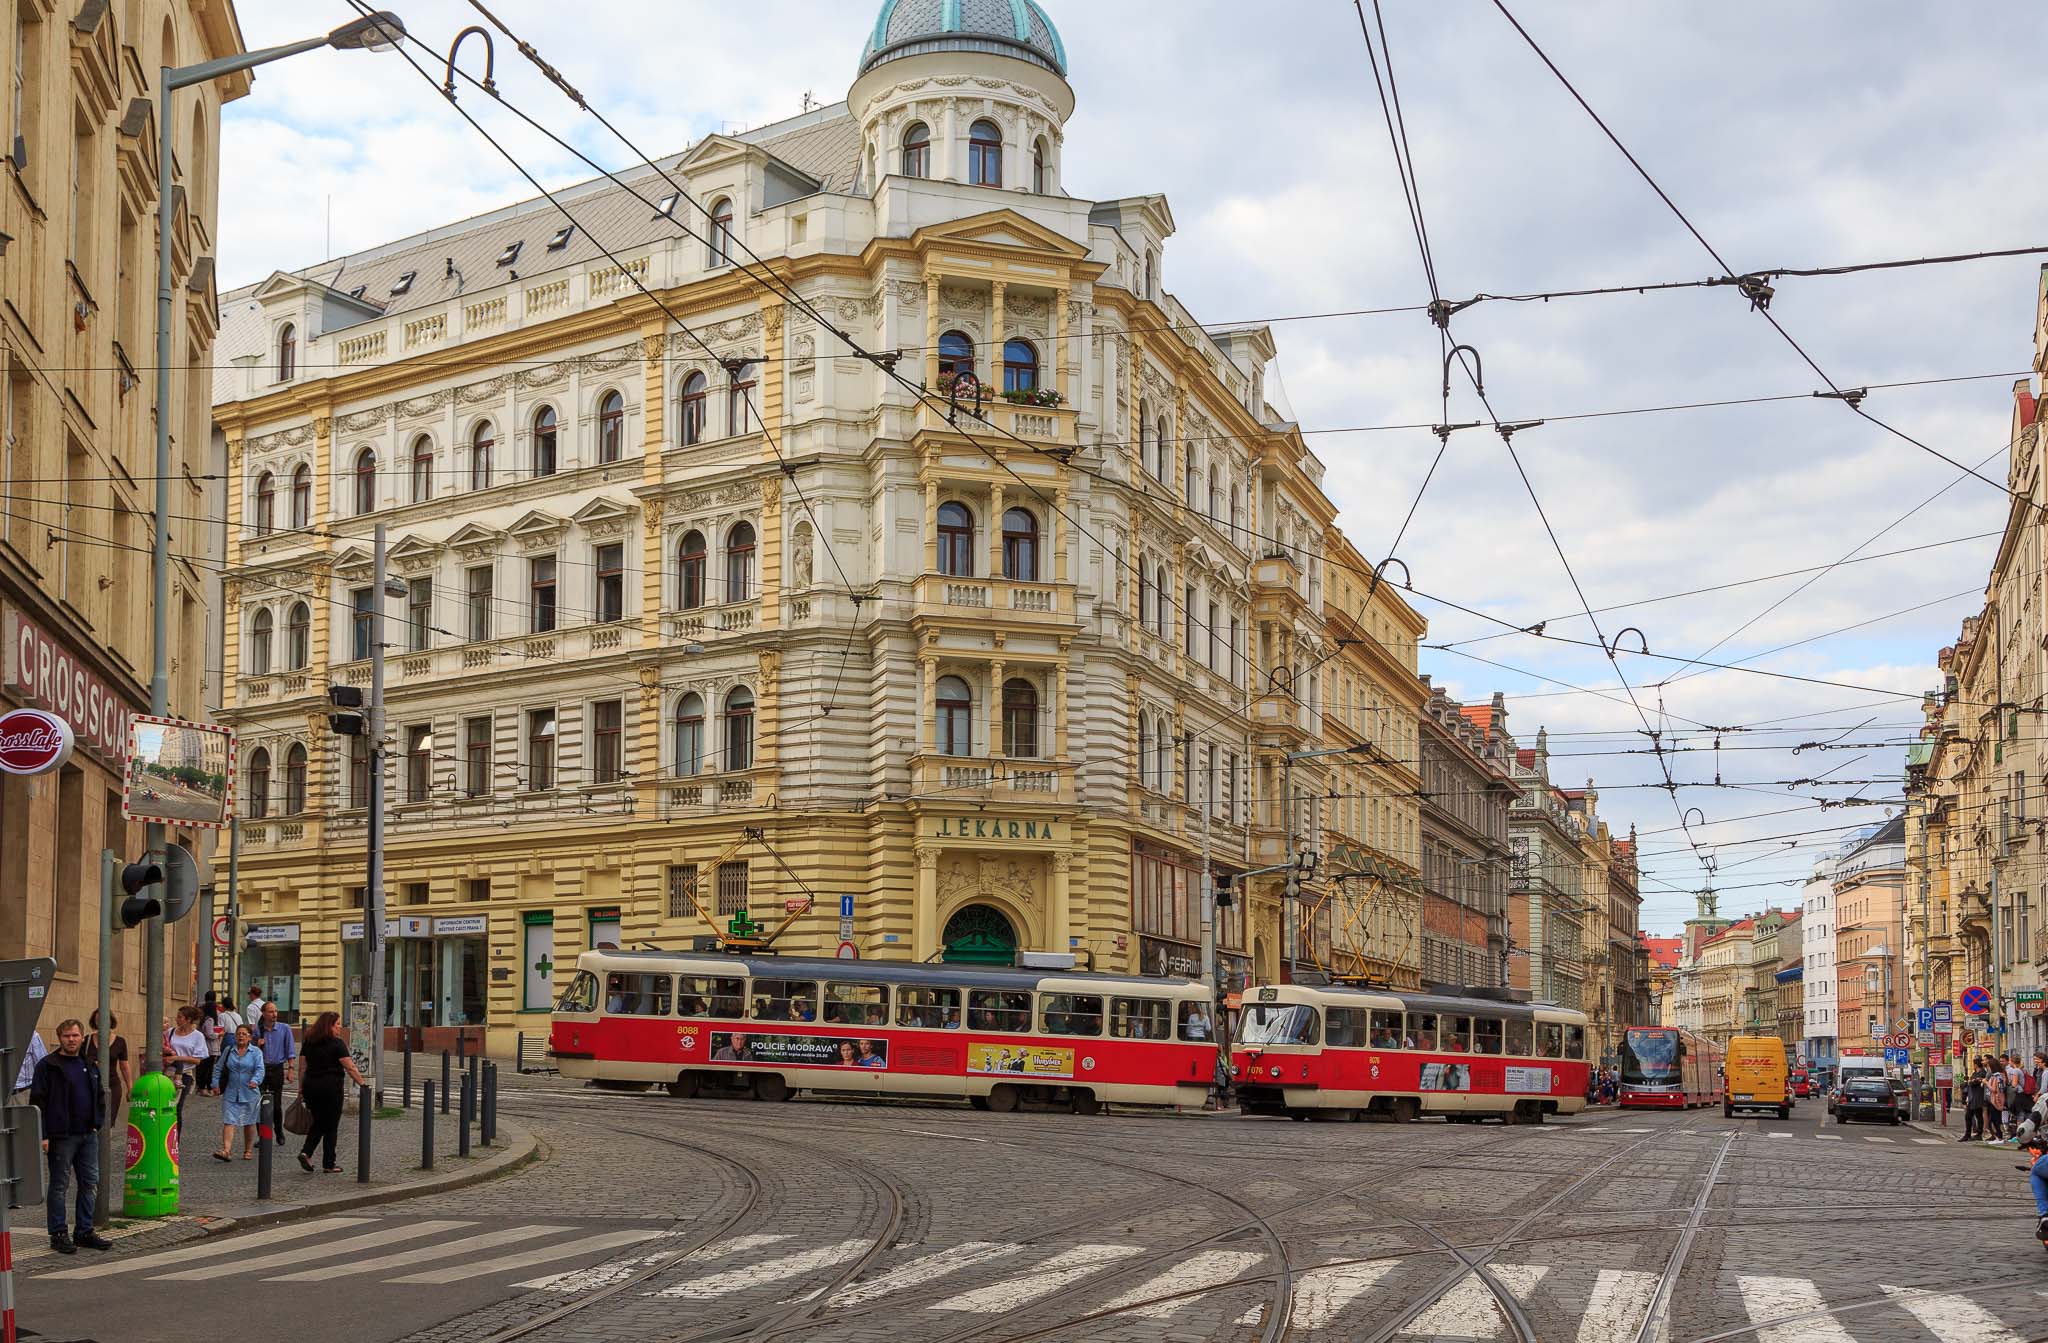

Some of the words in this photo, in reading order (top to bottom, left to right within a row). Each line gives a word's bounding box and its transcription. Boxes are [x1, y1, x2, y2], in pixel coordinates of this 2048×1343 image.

[21, 625, 125, 758] CROSSCA
[1262, 990, 1275, 1000] 25
[677, 1026, 698, 1035] 8088
[751, 1041, 786, 1051] POLICIE
[787, 1043, 833, 1053] MODRAVA
